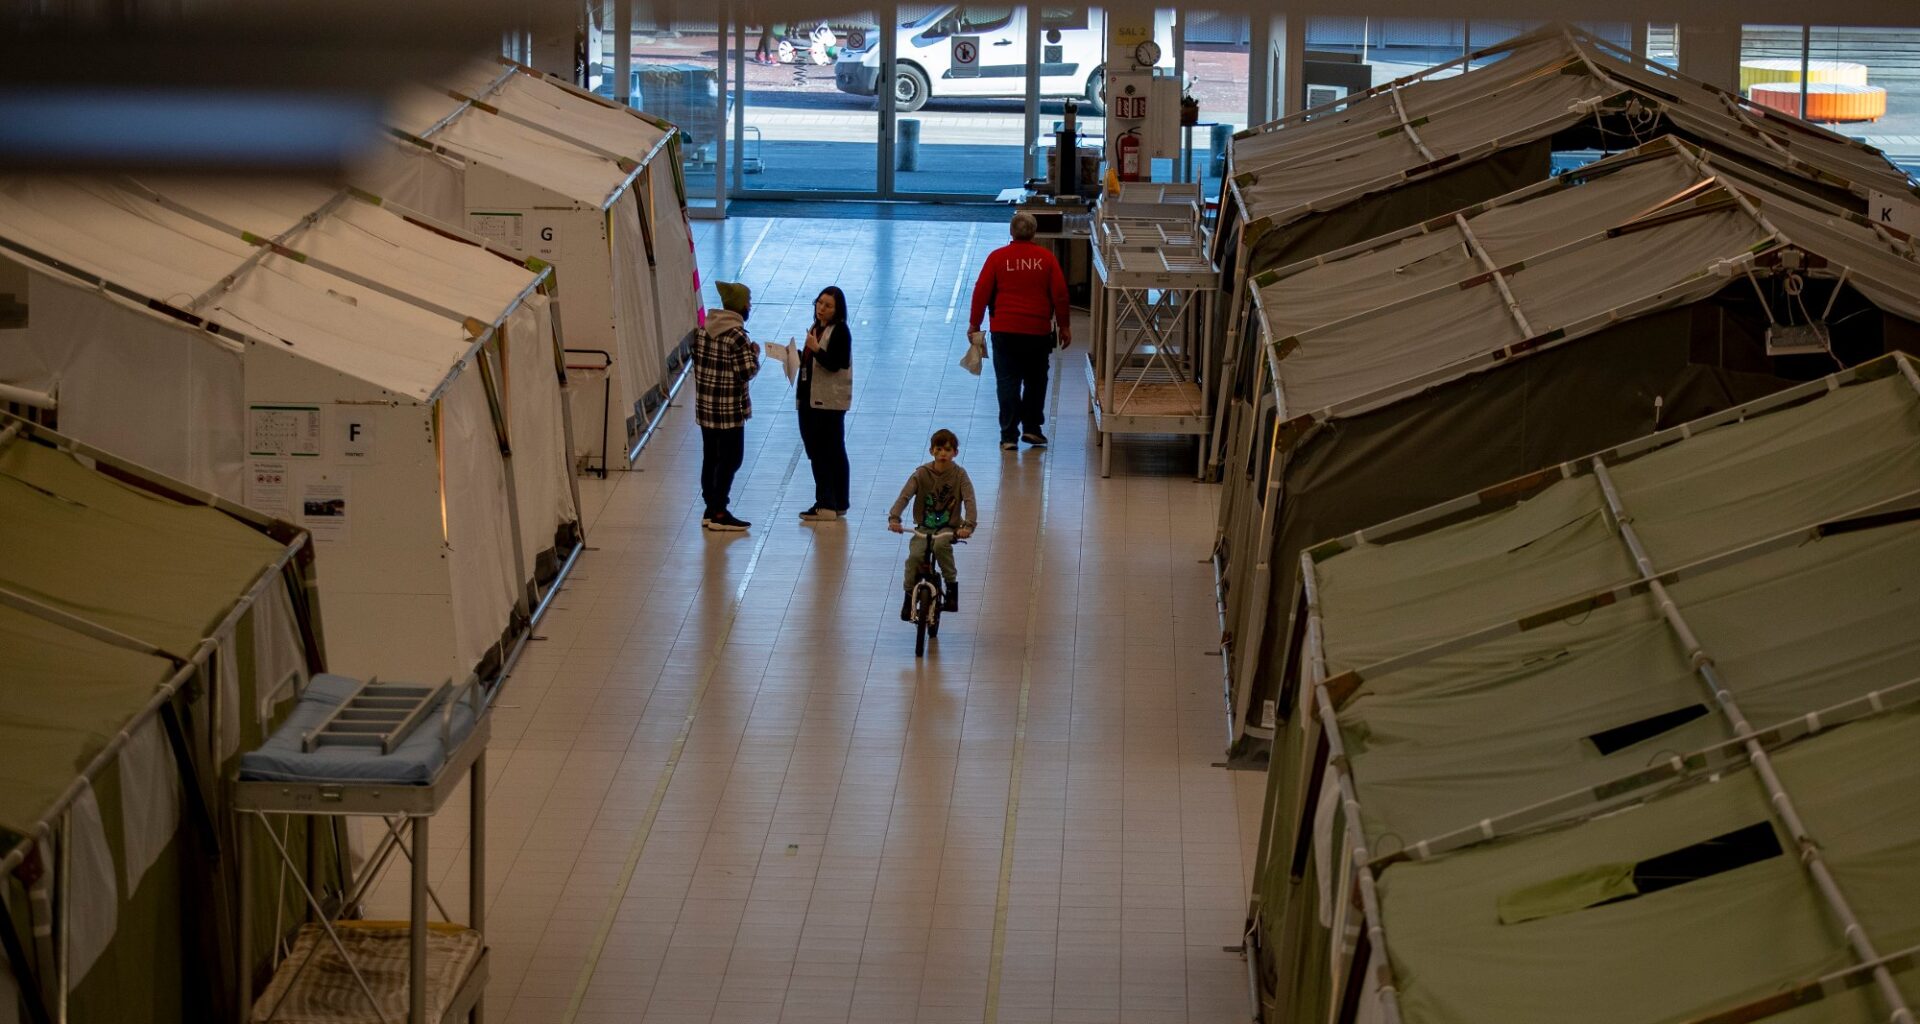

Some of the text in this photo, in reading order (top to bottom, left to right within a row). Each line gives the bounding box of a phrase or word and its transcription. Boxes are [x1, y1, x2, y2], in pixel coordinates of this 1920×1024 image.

[1119, 27, 1147, 36] SAL 2
[1881, 207, 1893, 222] K
[541, 227, 553, 241] G
[1006, 258, 1043, 272] LINK
[350, 423, 361, 442] F
